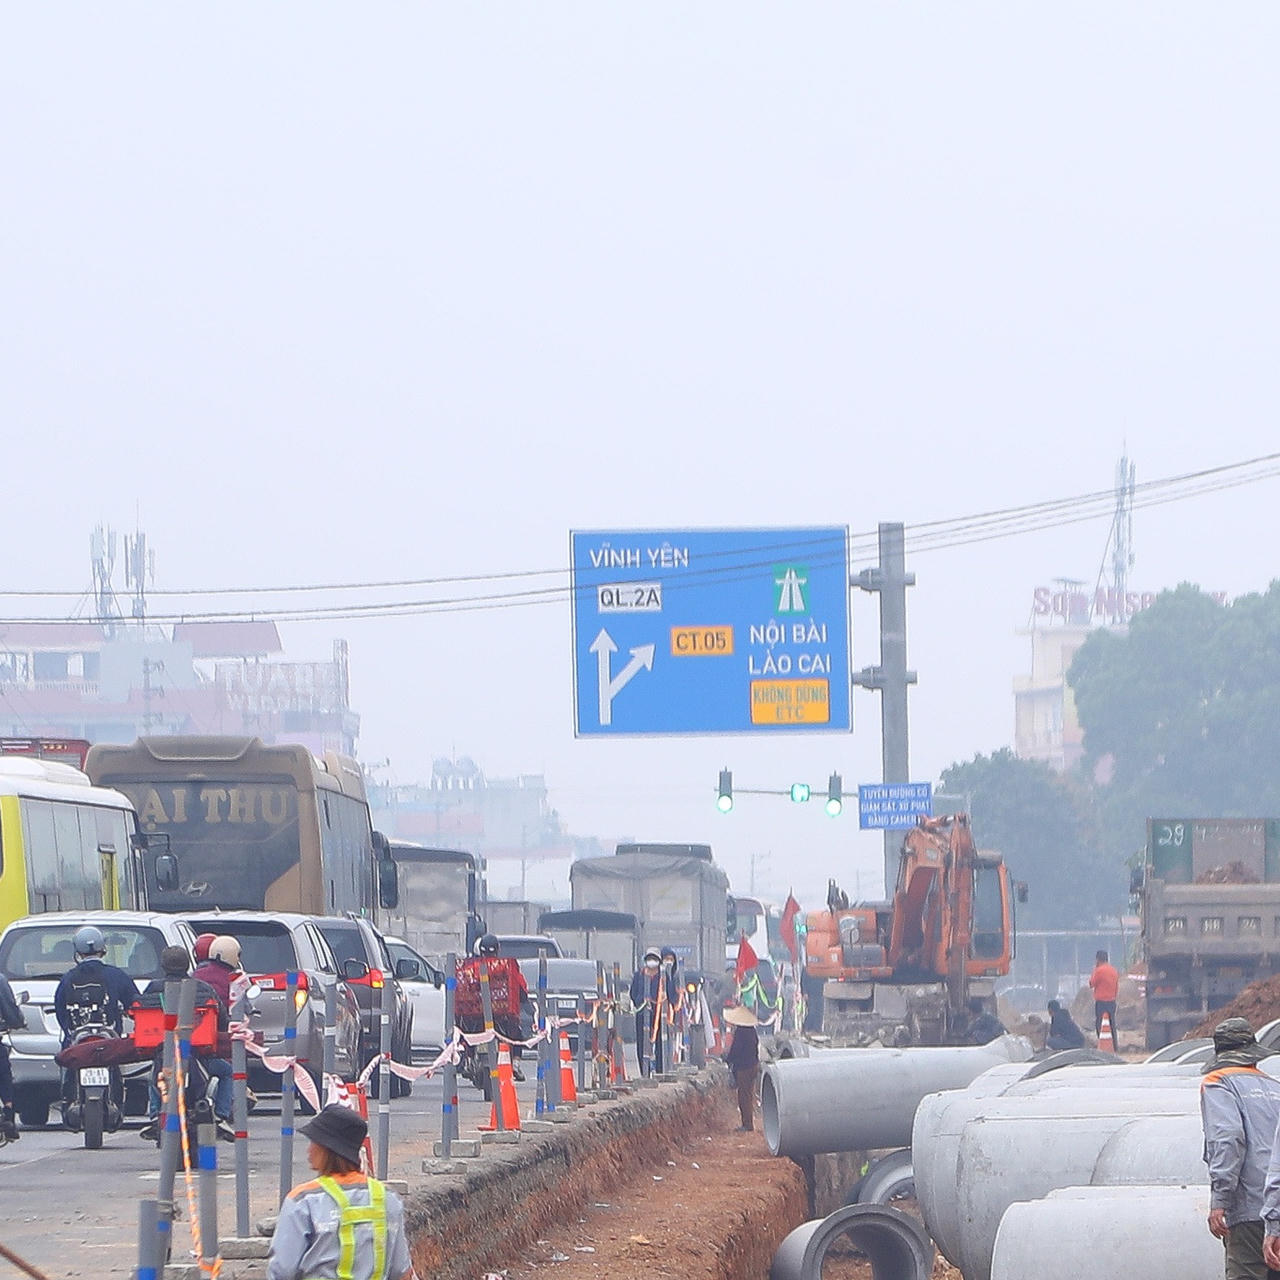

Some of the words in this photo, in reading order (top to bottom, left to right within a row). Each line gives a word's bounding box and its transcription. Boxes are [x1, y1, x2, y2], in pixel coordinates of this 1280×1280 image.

[589, 541, 641, 568] VĨNH
[648, 541, 689, 568] YÊN
[599, 587, 661, 607] QL.2A
[676, 632, 726, 651] CT.05
[749, 618, 786, 651] NỘI
[792, 618, 827, 644] BÀI
[748, 650, 792, 675] LÀO
[798, 653, 831, 674] CAI
[753, 685, 793, 704] KHÔNG
[776, 706, 804, 721] ETC
[128, 788, 187, 831] ẠI
